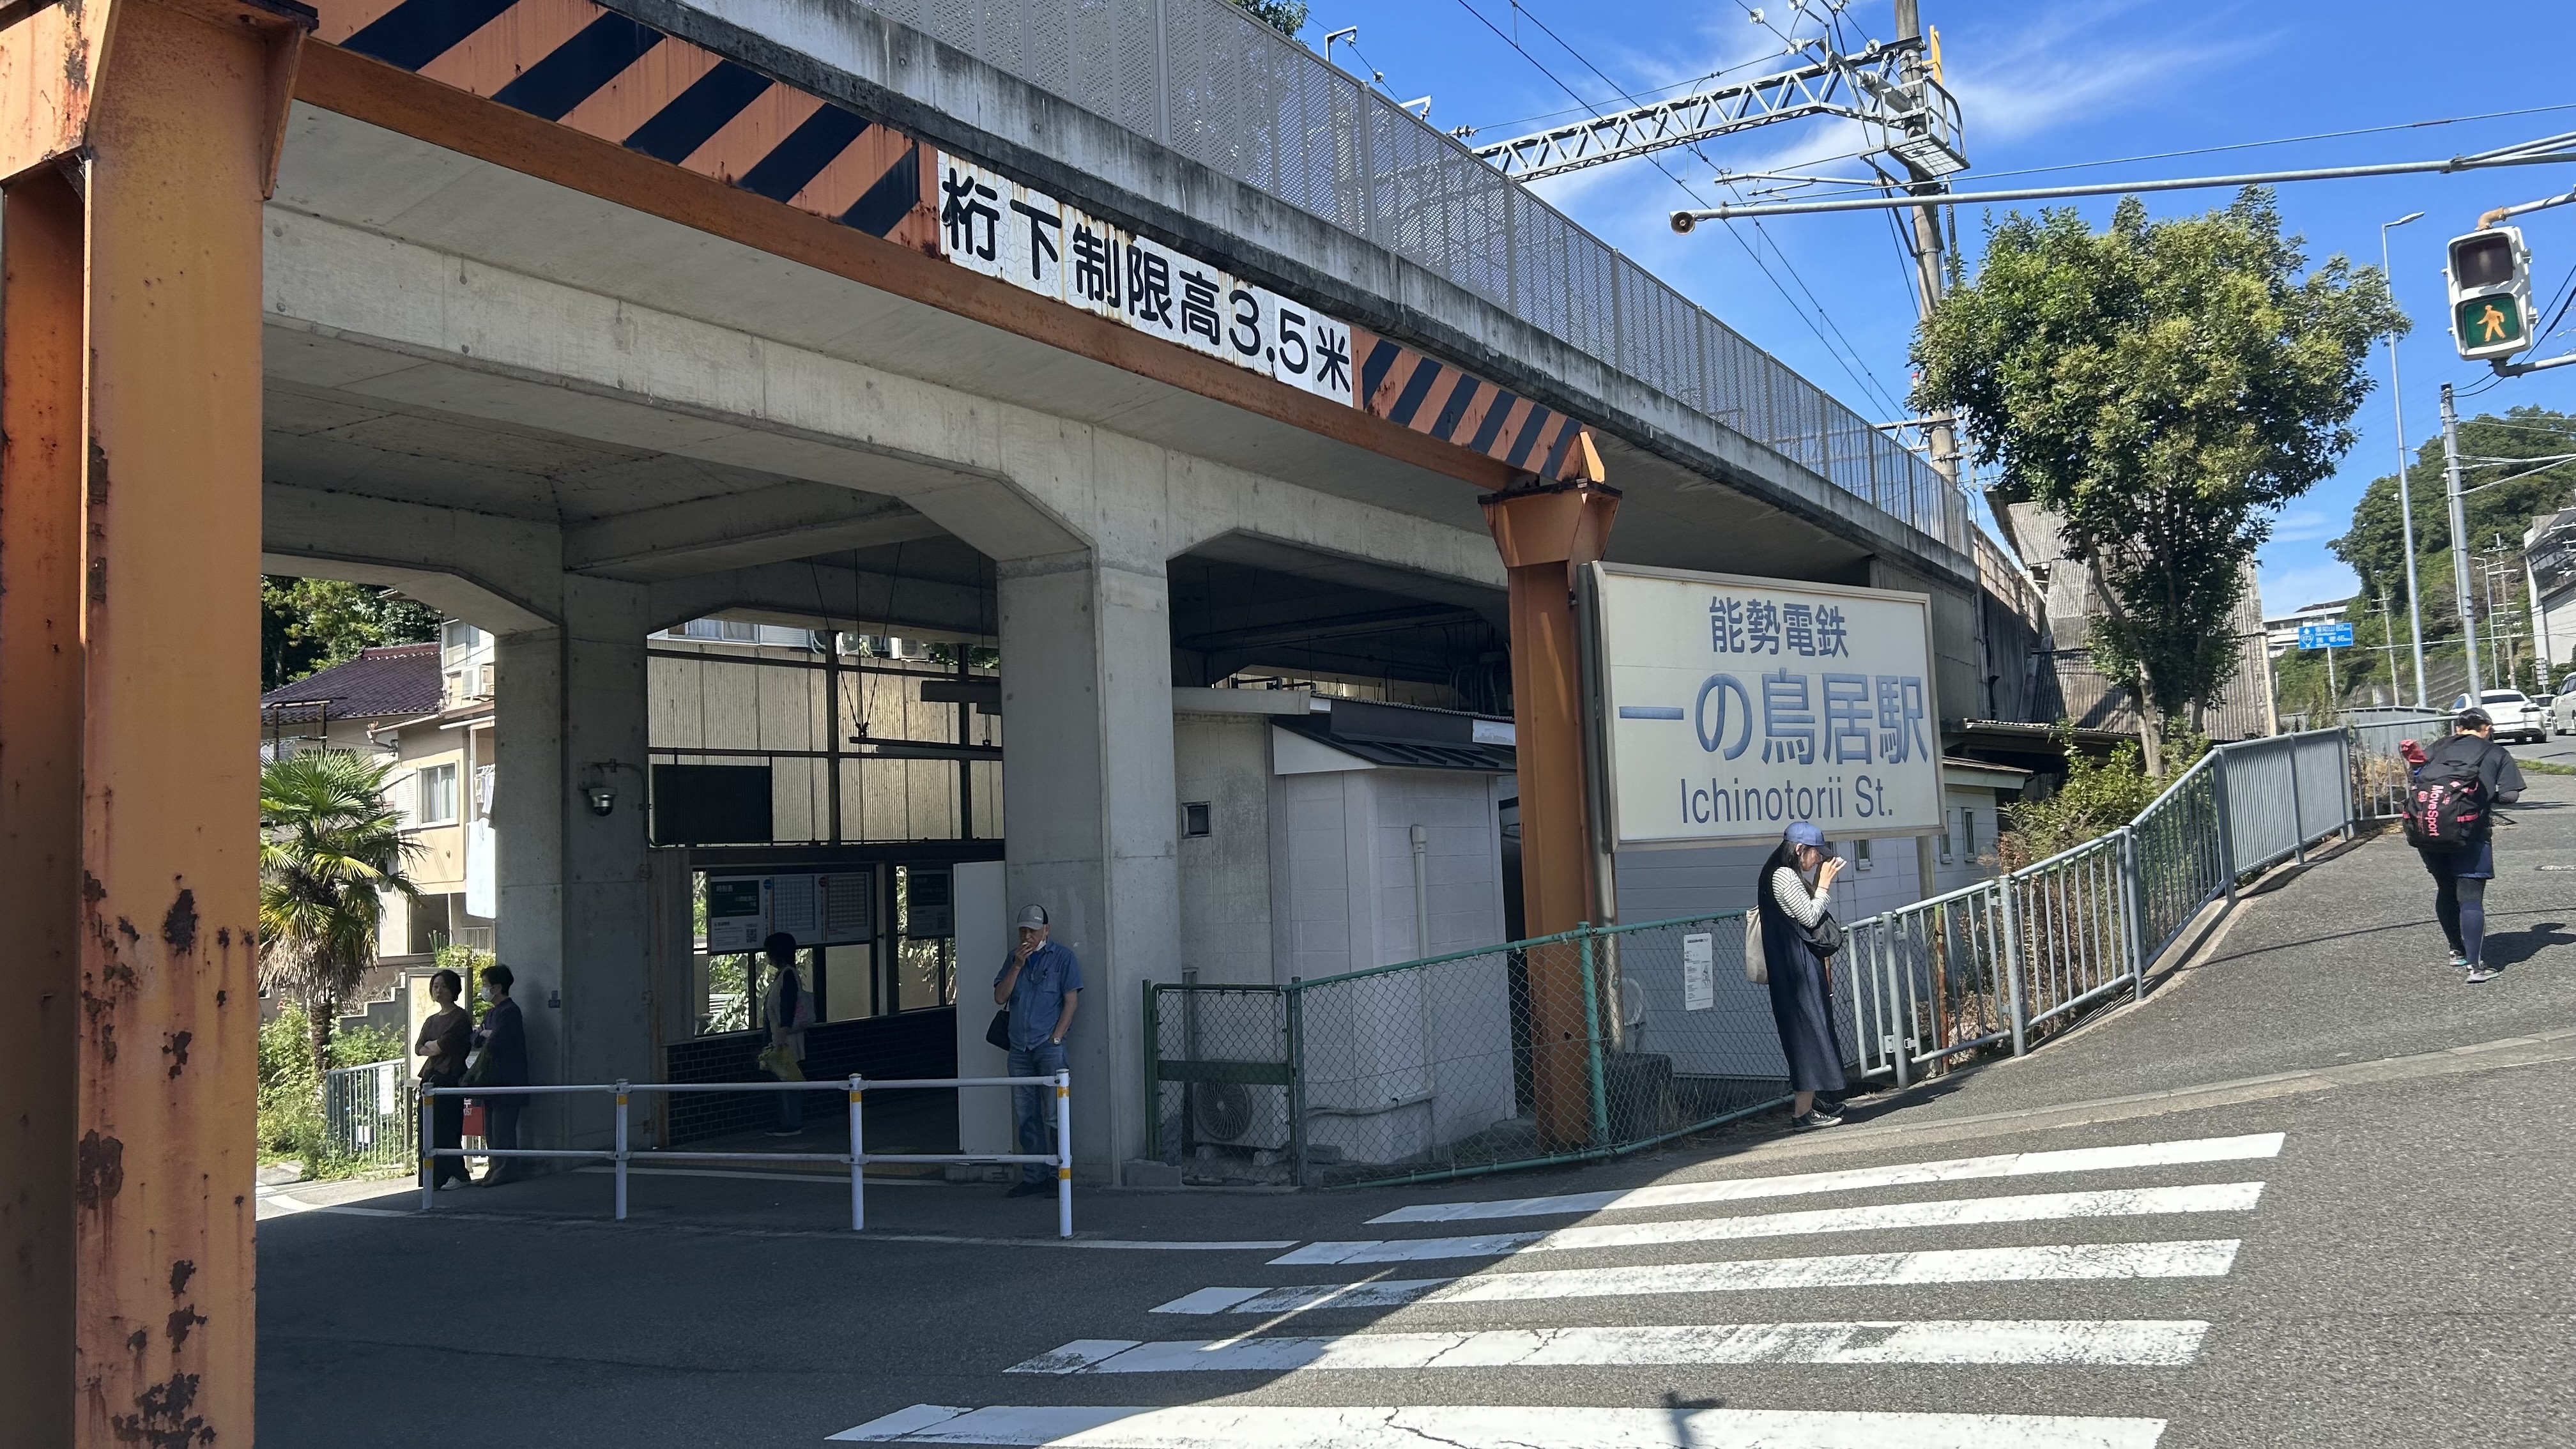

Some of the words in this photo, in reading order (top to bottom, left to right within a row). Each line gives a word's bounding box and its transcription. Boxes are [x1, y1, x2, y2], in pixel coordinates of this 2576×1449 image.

[941, 166, 1351, 394] 桁下制限高3.5米
[1708, 595, 1849, 659] 能勢電鉄
[1618, 667, 1928, 765] 一の鳥居駅
[1680, 776, 1843, 824] Ichinotorii
[1855, 774, 1893, 818] St.
[2424, 785, 2444, 837] MoveSport
